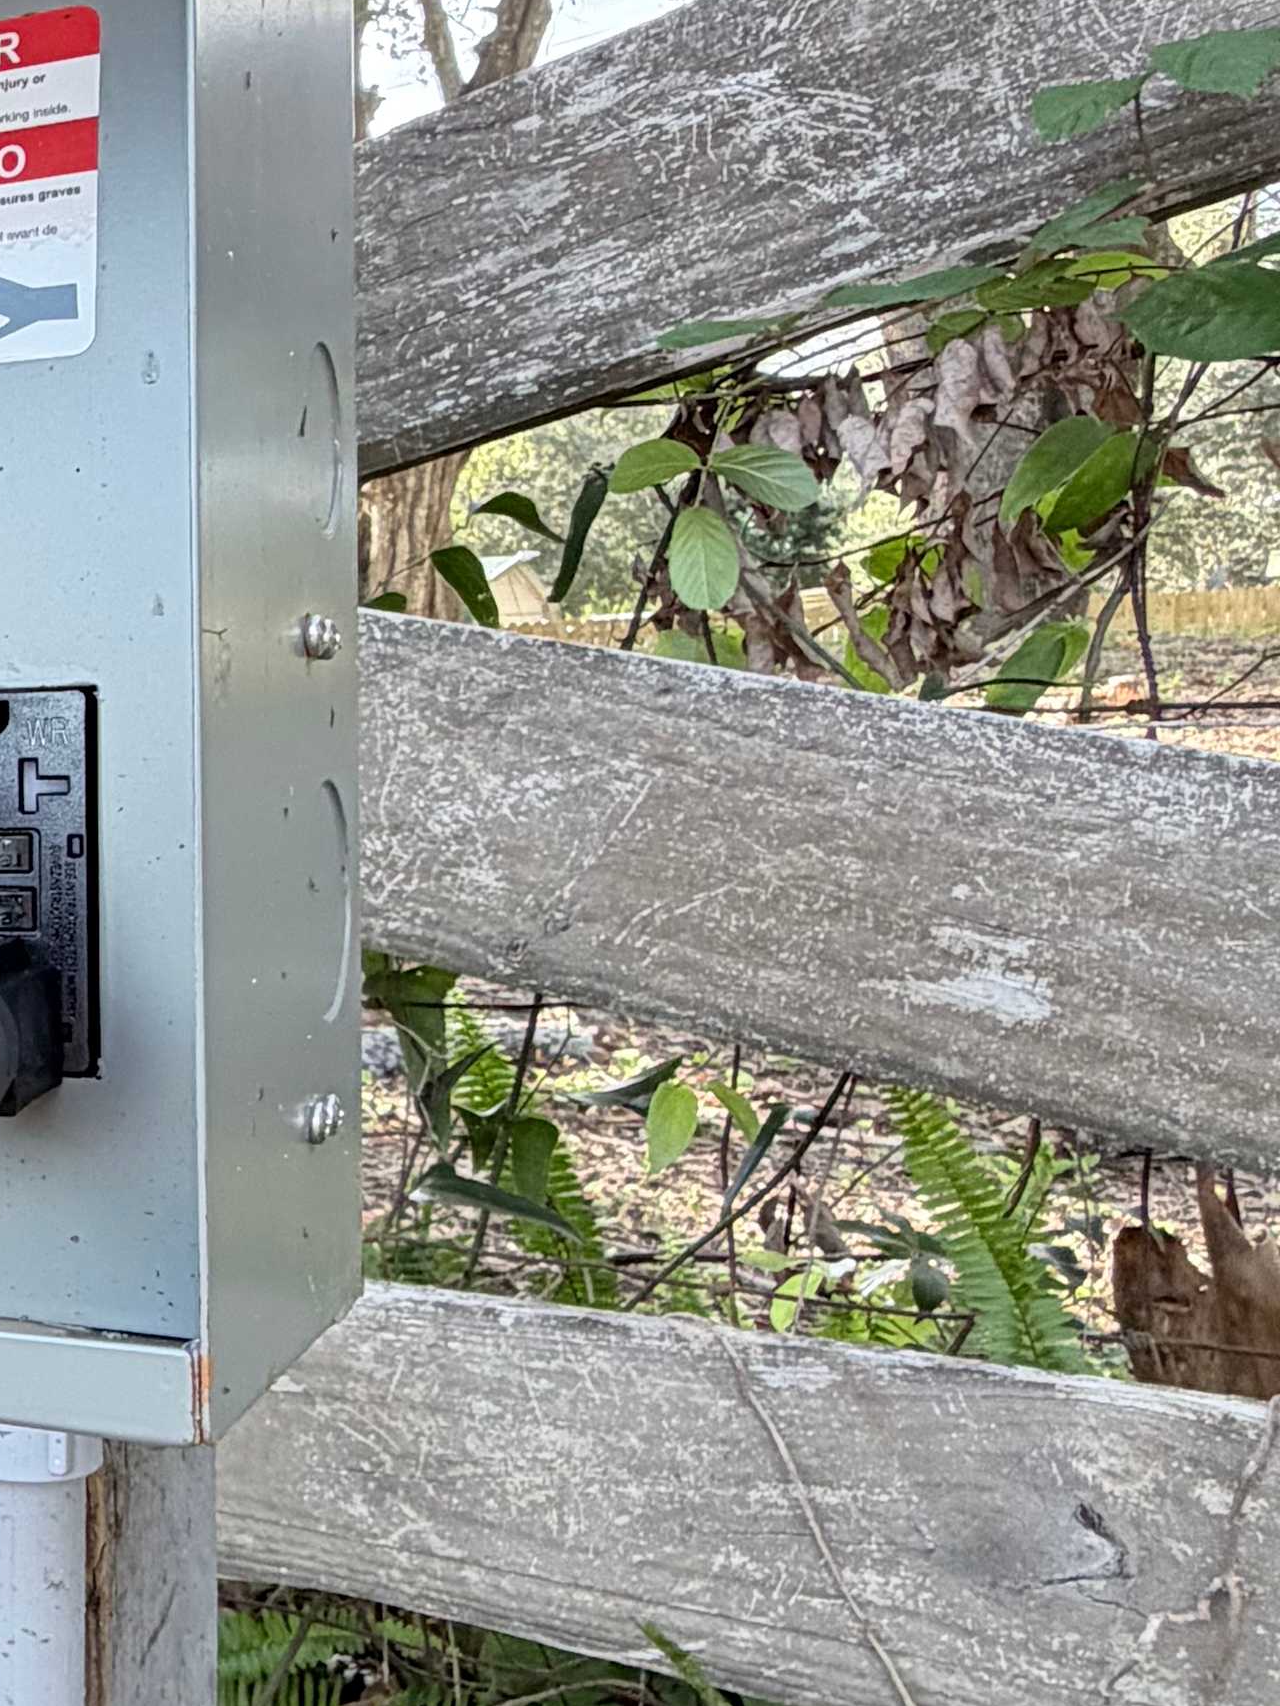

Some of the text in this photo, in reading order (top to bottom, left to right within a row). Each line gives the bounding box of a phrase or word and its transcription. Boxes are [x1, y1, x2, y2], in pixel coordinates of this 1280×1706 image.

[31, 73, 46, 84] or
[32, 103, 71, 118] inside.
[37, 185, 81, 203] graves
[26, 717, 70, 747] WR
